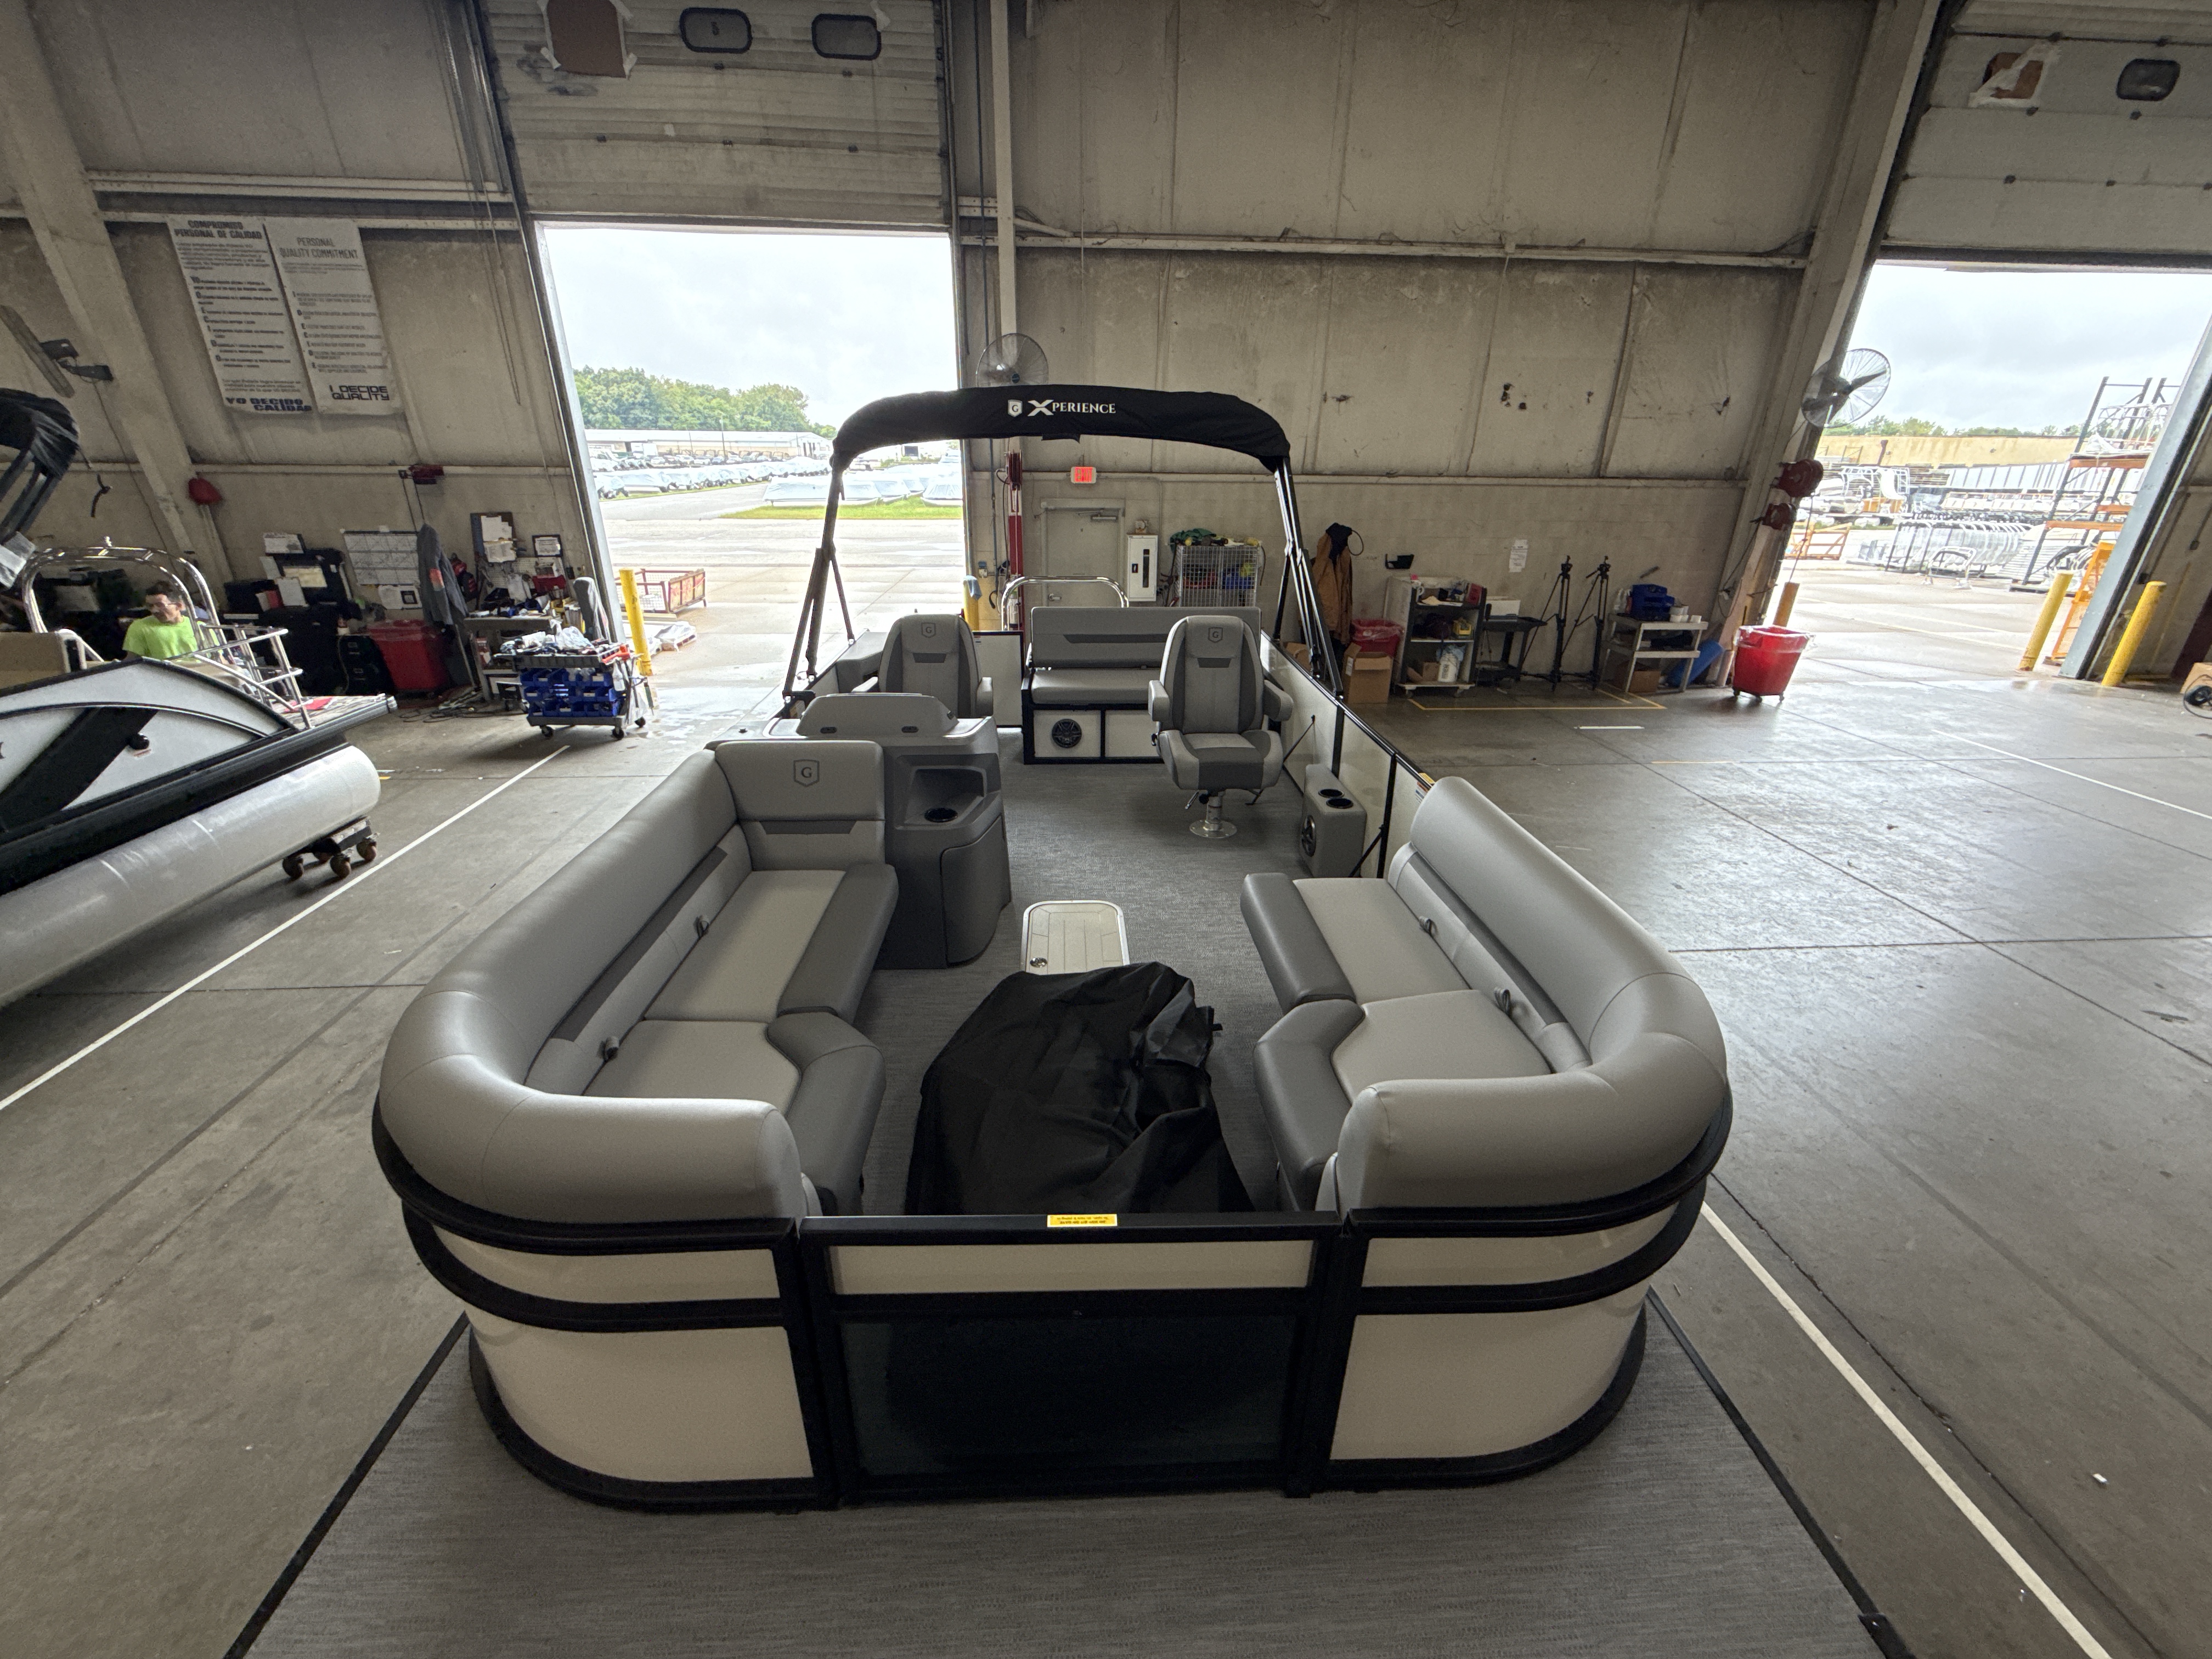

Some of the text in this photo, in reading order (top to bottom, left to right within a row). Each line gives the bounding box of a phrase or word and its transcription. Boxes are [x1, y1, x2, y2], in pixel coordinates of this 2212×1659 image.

[296, 237, 336, 247] PERSONAL
[279, 247, 358, 259] QUALITY COMMITMENT
[1012, 404, 1019, 413] G
[1027, 399, 1116, 417] XPERIENCE
[1075, 467, 1093, 482] EXIT
[801, 766, 812, 778] G
